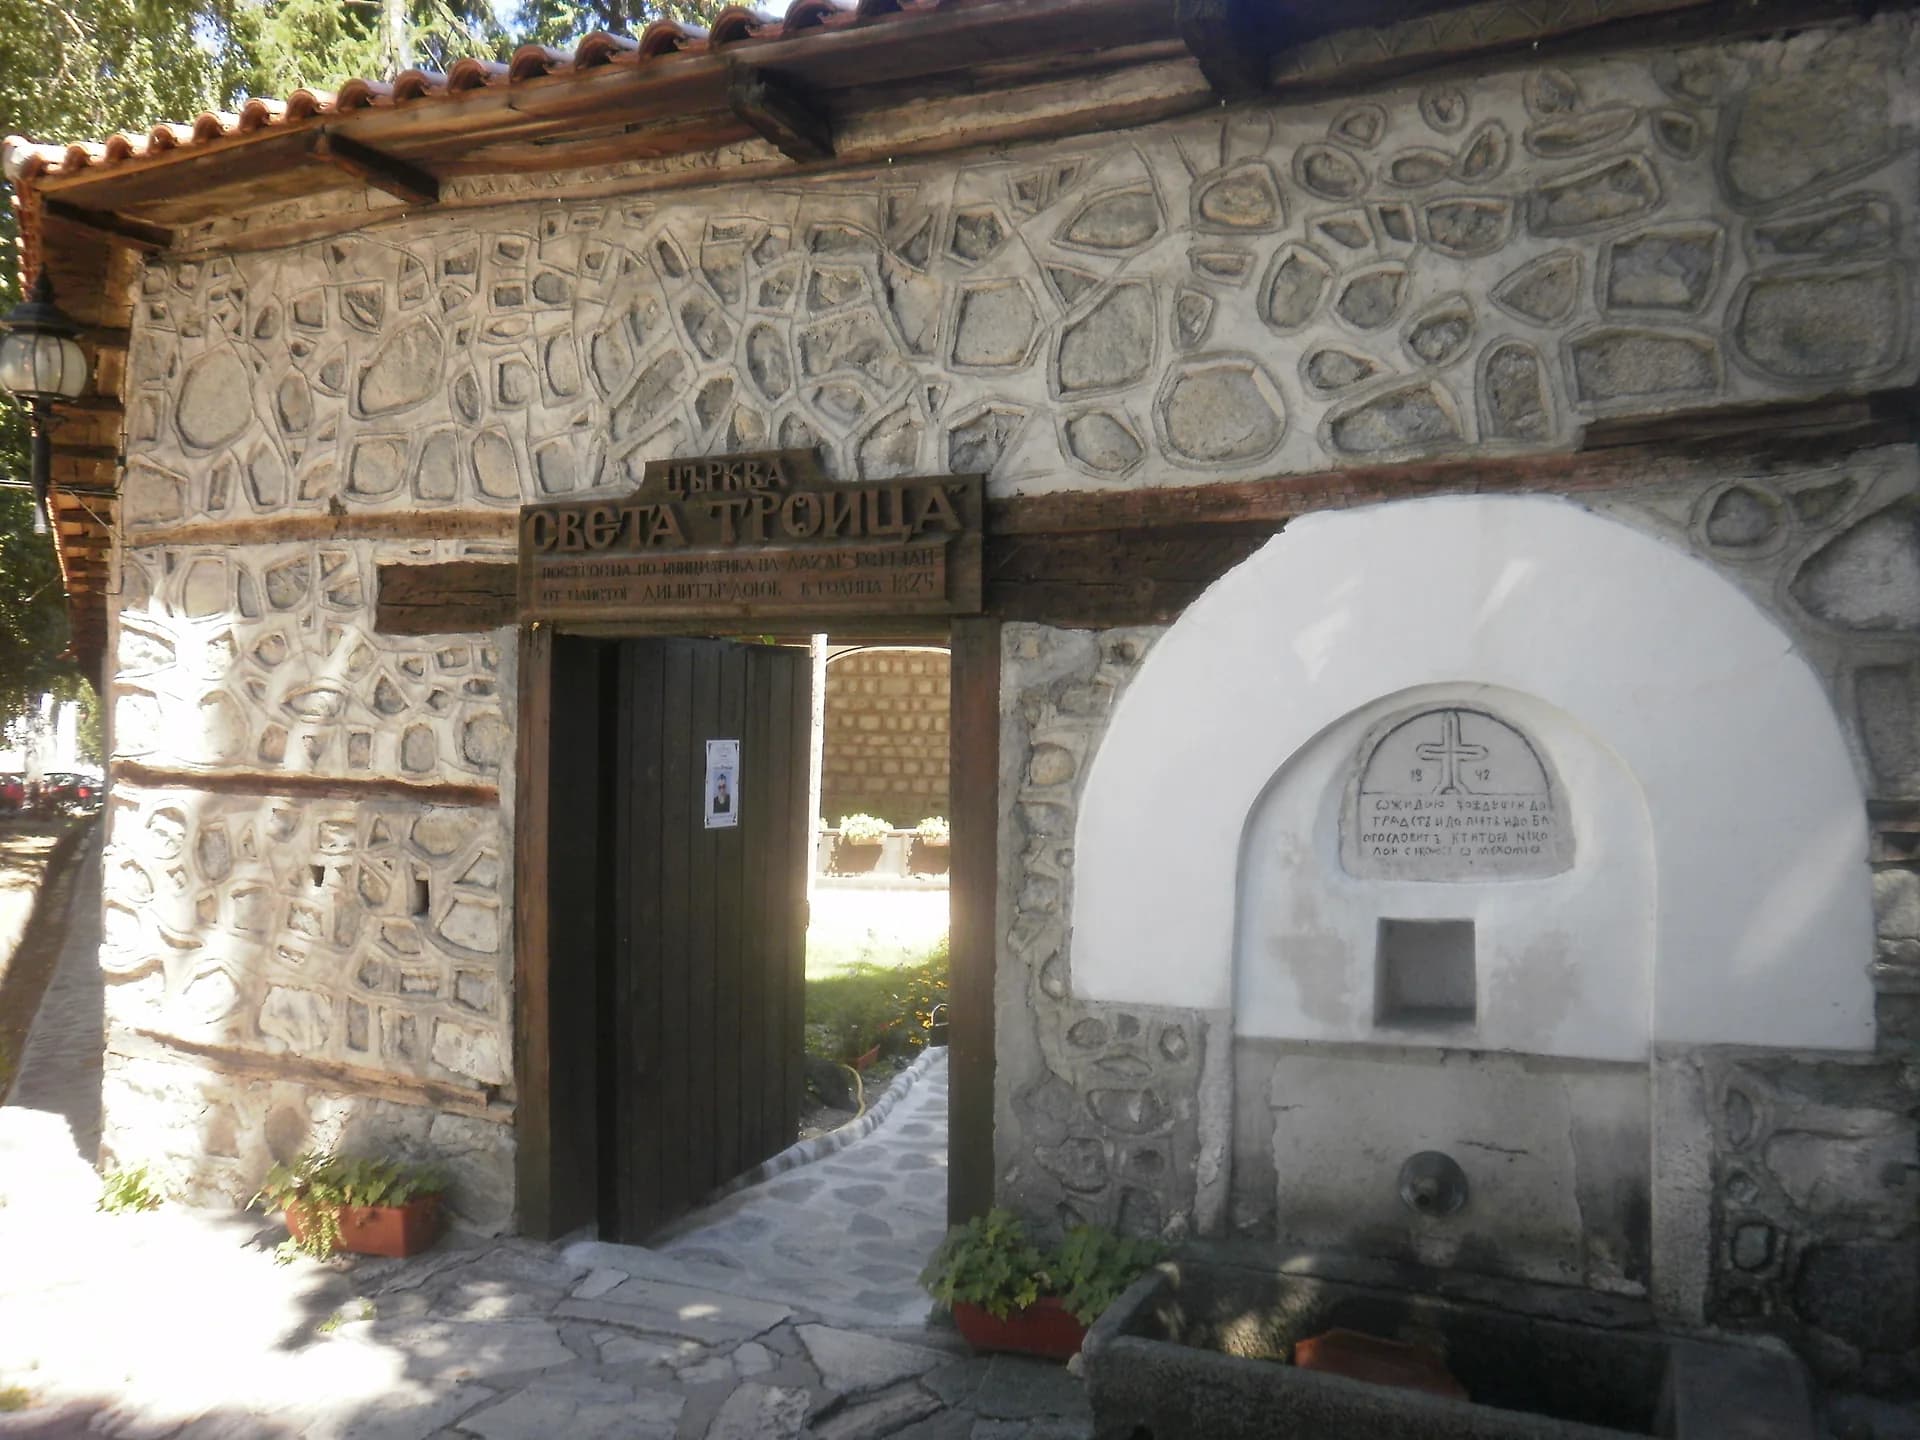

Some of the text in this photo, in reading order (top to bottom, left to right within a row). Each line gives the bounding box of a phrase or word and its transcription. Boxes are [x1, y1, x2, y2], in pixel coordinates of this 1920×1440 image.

[666, 459, 787, 499] ЦЪРКВА
[525, 484, 967, 551] СВЕТА ТРОИЦА
